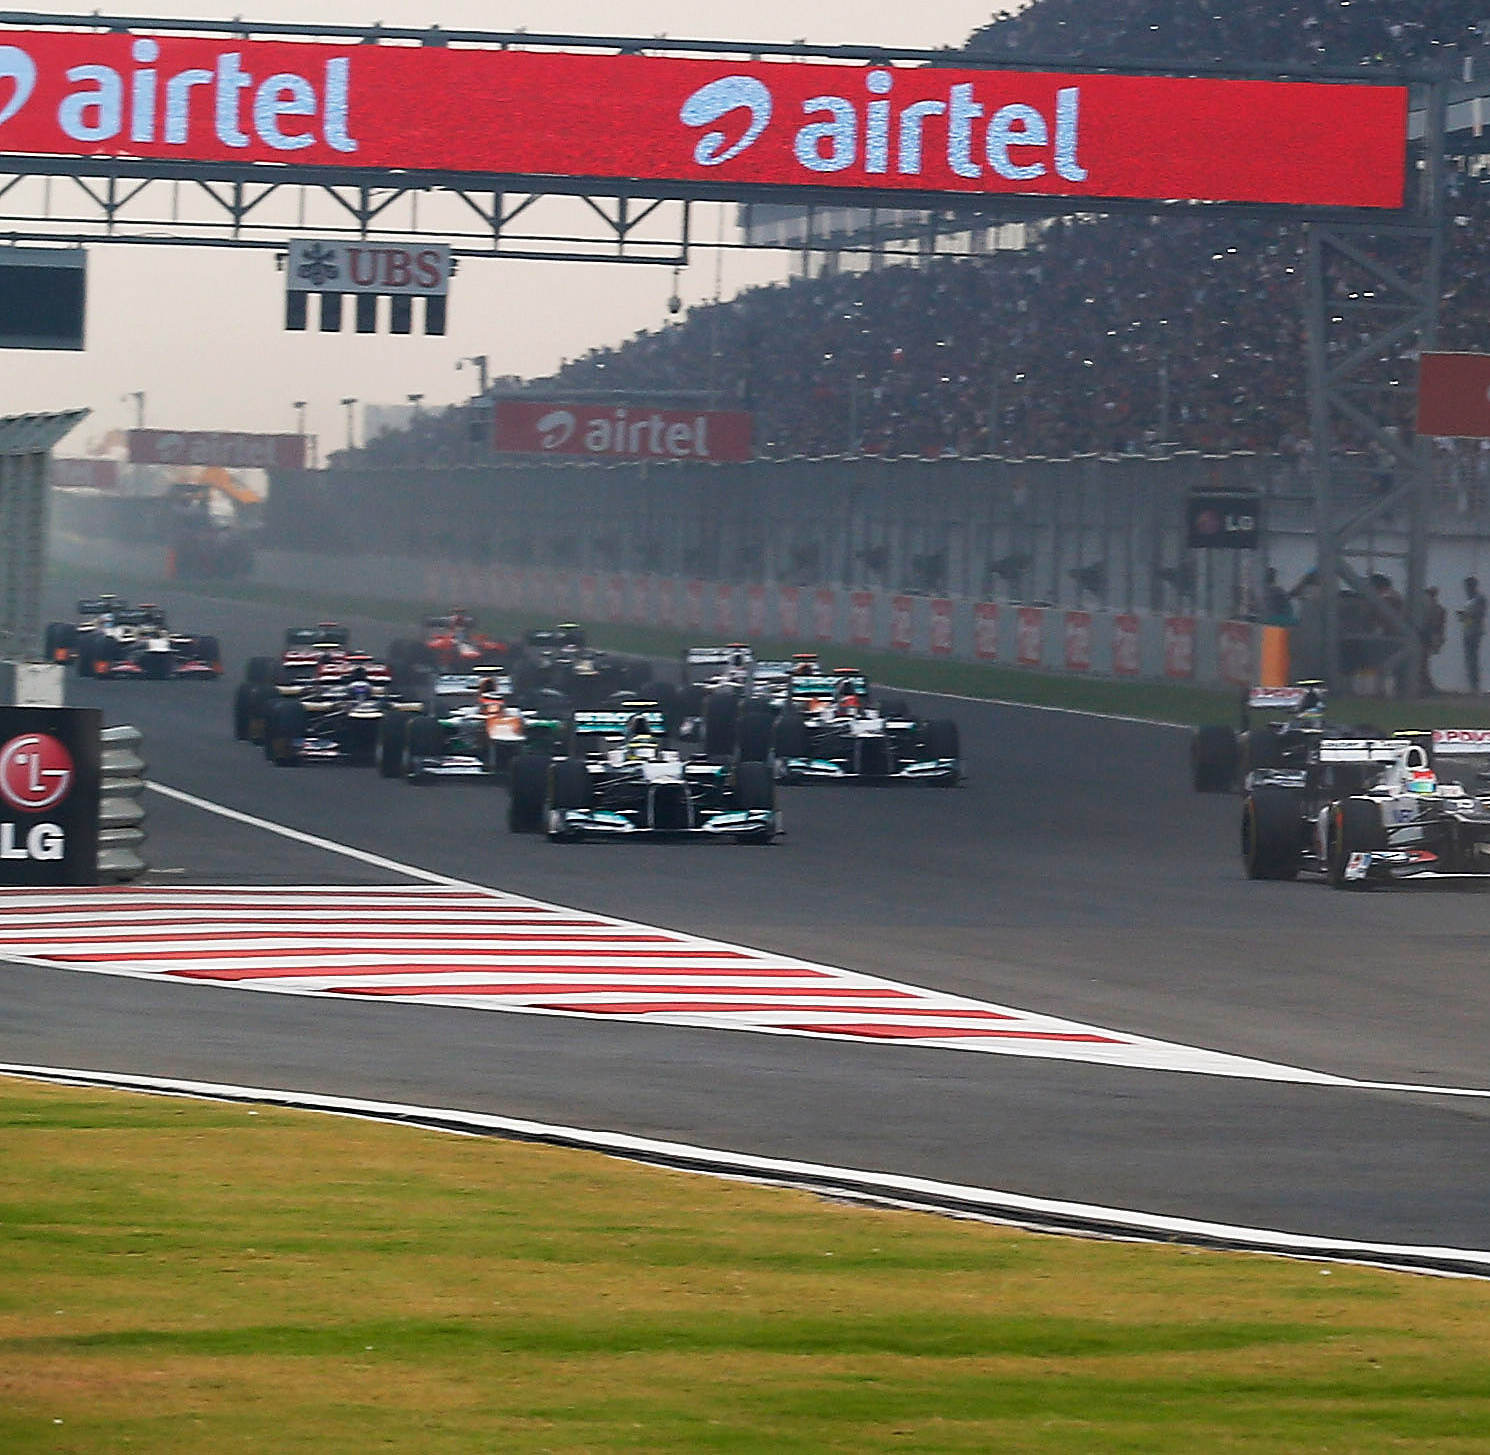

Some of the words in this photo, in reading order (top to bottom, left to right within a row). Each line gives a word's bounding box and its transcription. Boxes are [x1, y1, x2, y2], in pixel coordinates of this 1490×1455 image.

[57, 39, 358, 153] airtel
[794, 70, 1089, 183] airtel
[345, 247, 443, 289] UBS
[584, 408, 711, 458] airtel
[0, 822, 65, 860] LG
